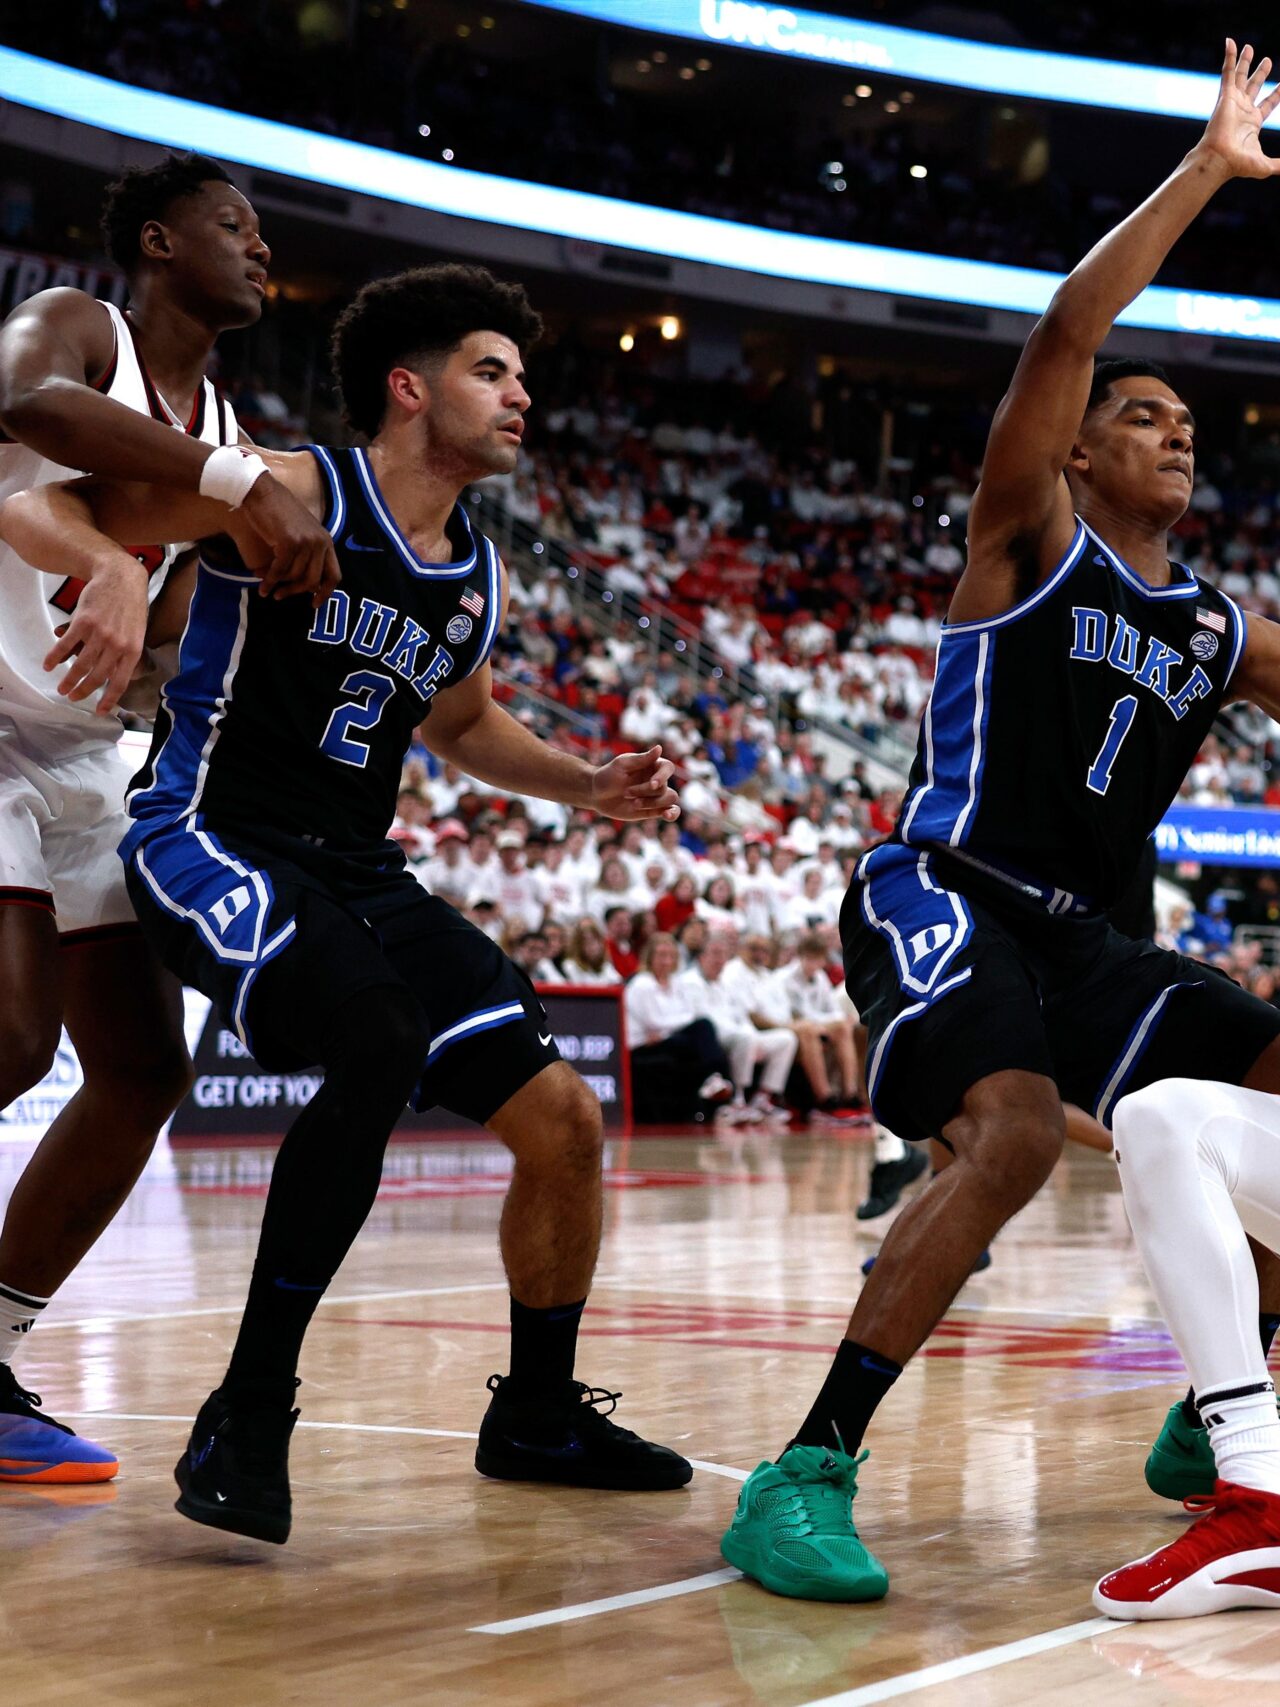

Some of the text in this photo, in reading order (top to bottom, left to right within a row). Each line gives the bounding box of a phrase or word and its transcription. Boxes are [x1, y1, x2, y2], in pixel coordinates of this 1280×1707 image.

[307, 589, 455, 701] DUKE
[1069, 606, 1213, 721] DUKE
[319, 669, 397, 768] 2
[1086, 694, 1139, 796] 1
[193, 1075, 239, 1107] GET
[239, 1075, 282, 1107] OFF
[217, 1029, 251, 1058] FO
[553, 1034, 581, 1061] ND
